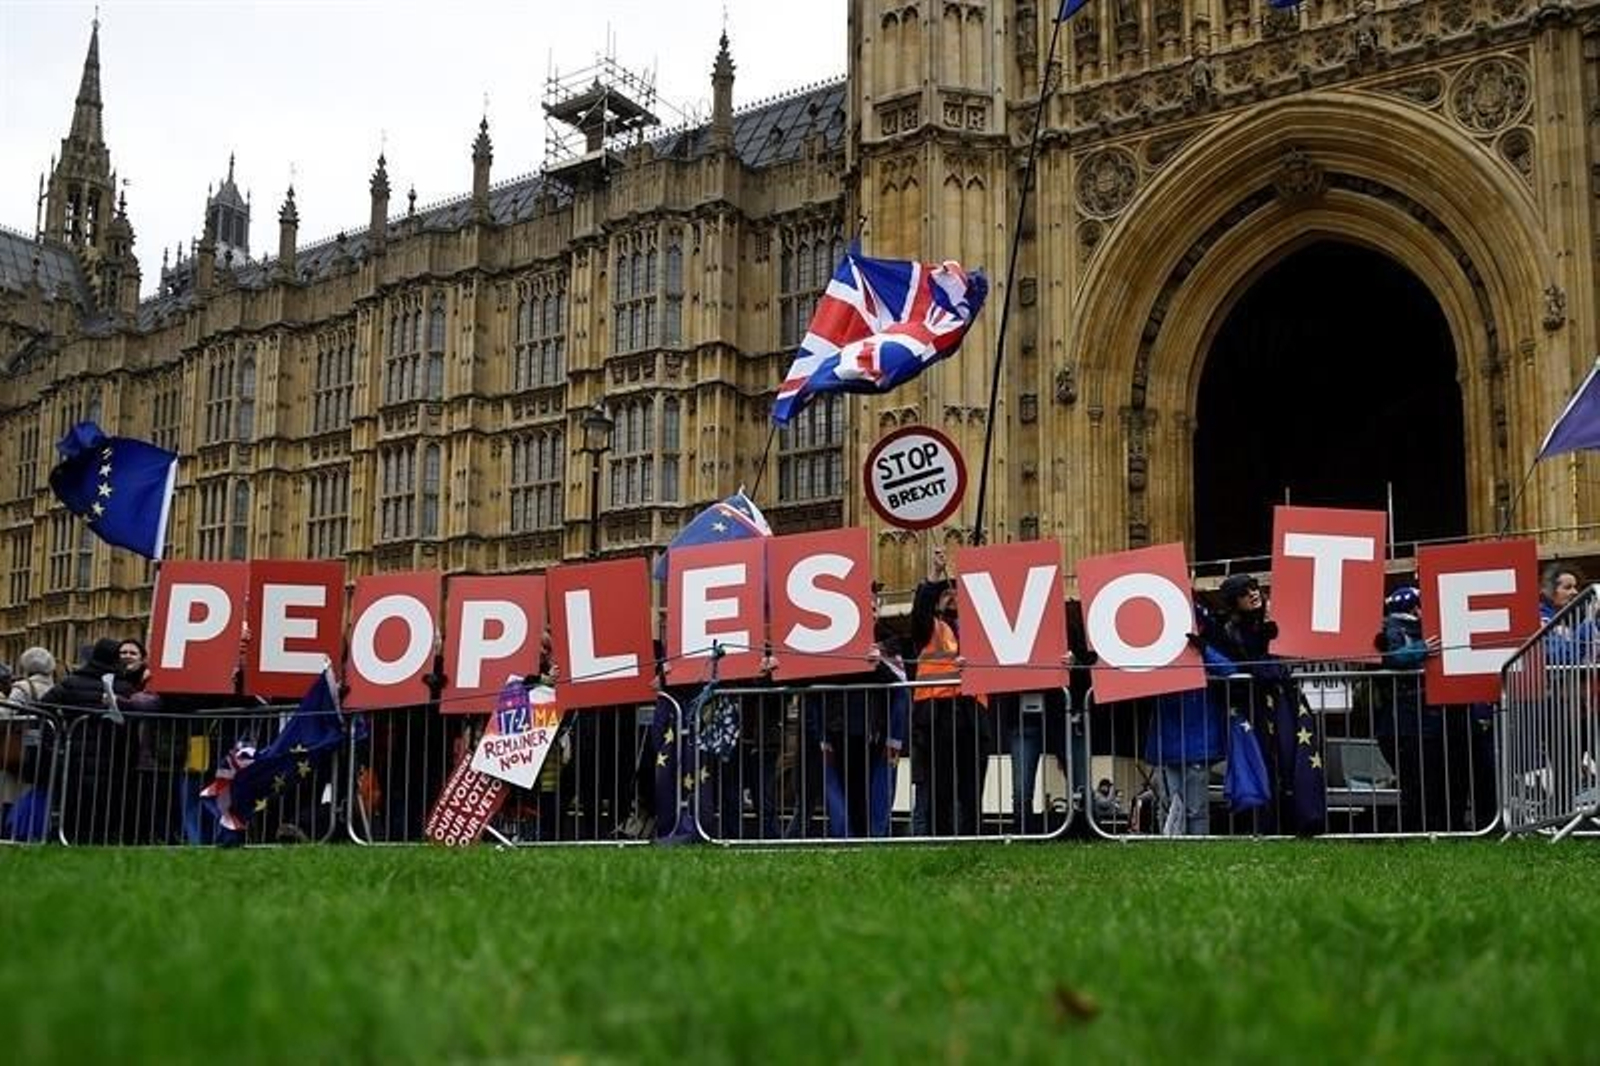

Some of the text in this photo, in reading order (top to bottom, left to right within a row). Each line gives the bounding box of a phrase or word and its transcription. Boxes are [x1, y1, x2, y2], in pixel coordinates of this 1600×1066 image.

[877, 442, 938, 480] STOP
[887, 479, 946, 509] BREXIT
[160, 532, 1525, 688] PEOPLES VOTE
[484, 730, 548, 759] REMAINER
[500, 749, 533, 771] NOW
[435, 807, 455, 840] OUR
[445, 773, 490, 847] OUR VOTE
[459, 780, 502, 847] OUR VETO
